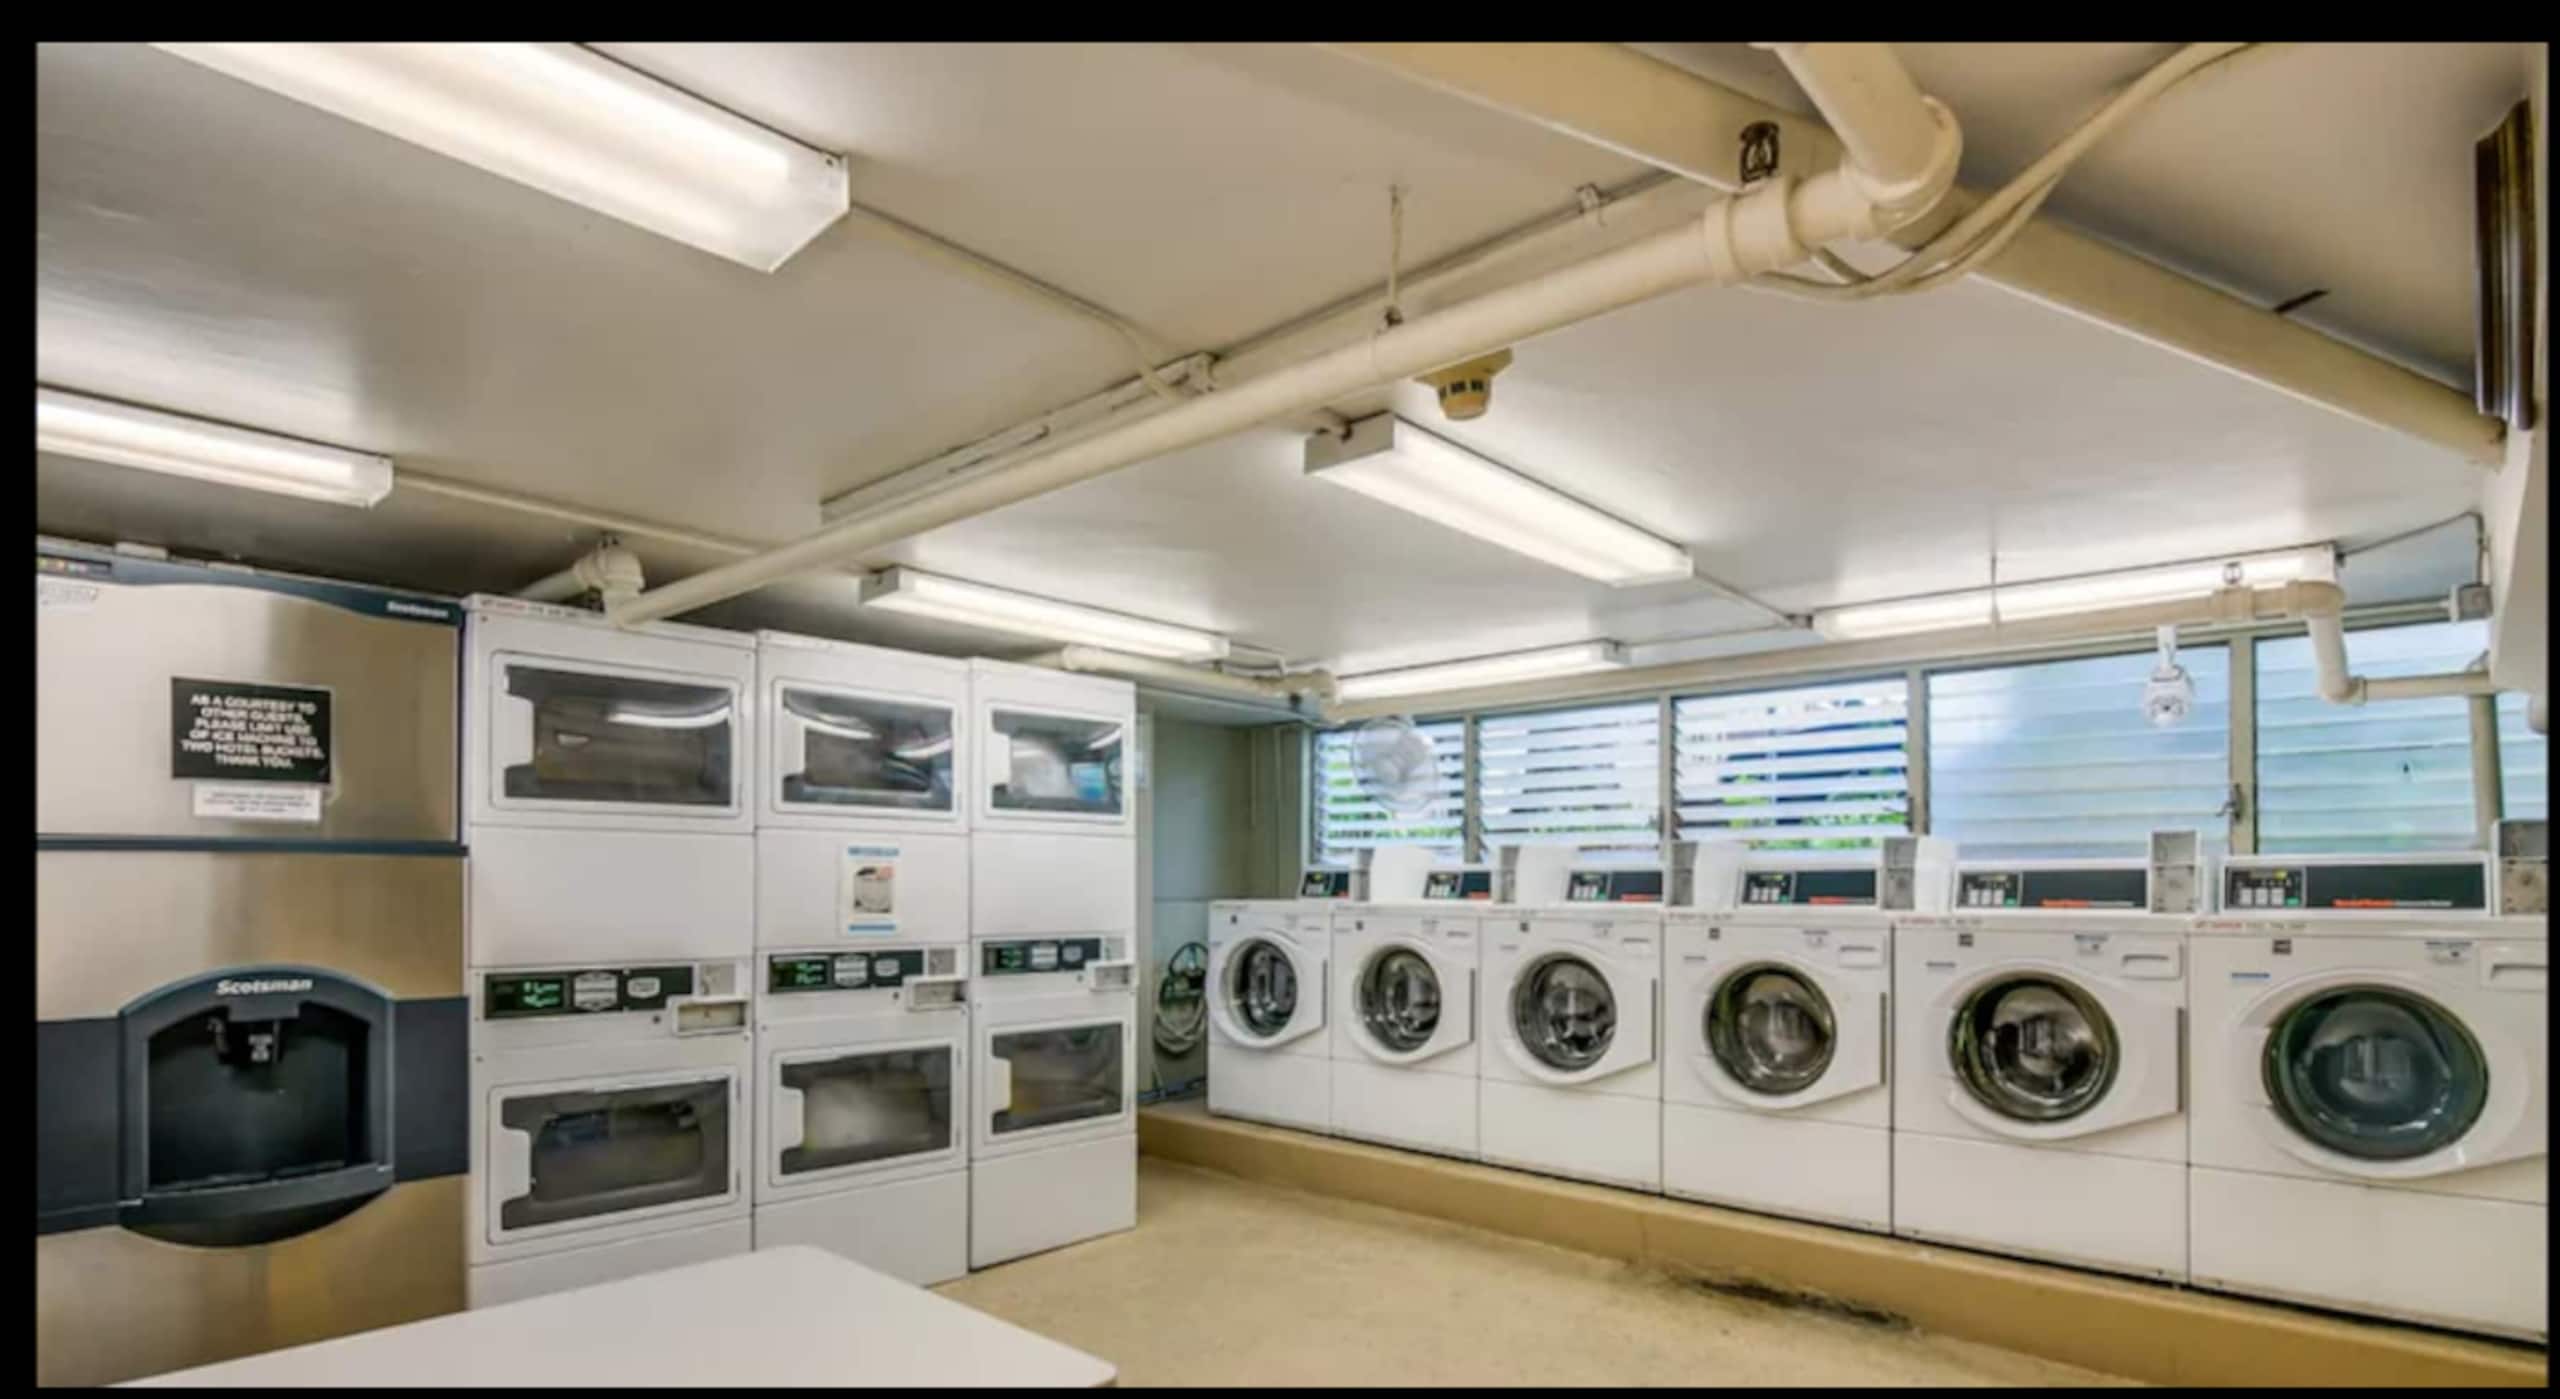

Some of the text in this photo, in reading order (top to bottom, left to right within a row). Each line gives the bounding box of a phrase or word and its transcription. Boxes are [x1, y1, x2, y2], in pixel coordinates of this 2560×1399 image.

[212, 696, 223, 707] A
[224, 697, 296, 712] COURTESY
[201, 708, 249, 719] OTHER
[194, 718, 247, 731] PLEASE
[189, 729, 210, 740] OF
[180, 739, 214, 753] TWO
[215, 743, 259, 754] HOTEL
[214, 753, 260, 767] THANK
[216, 979, 312, 996] Scotsman
